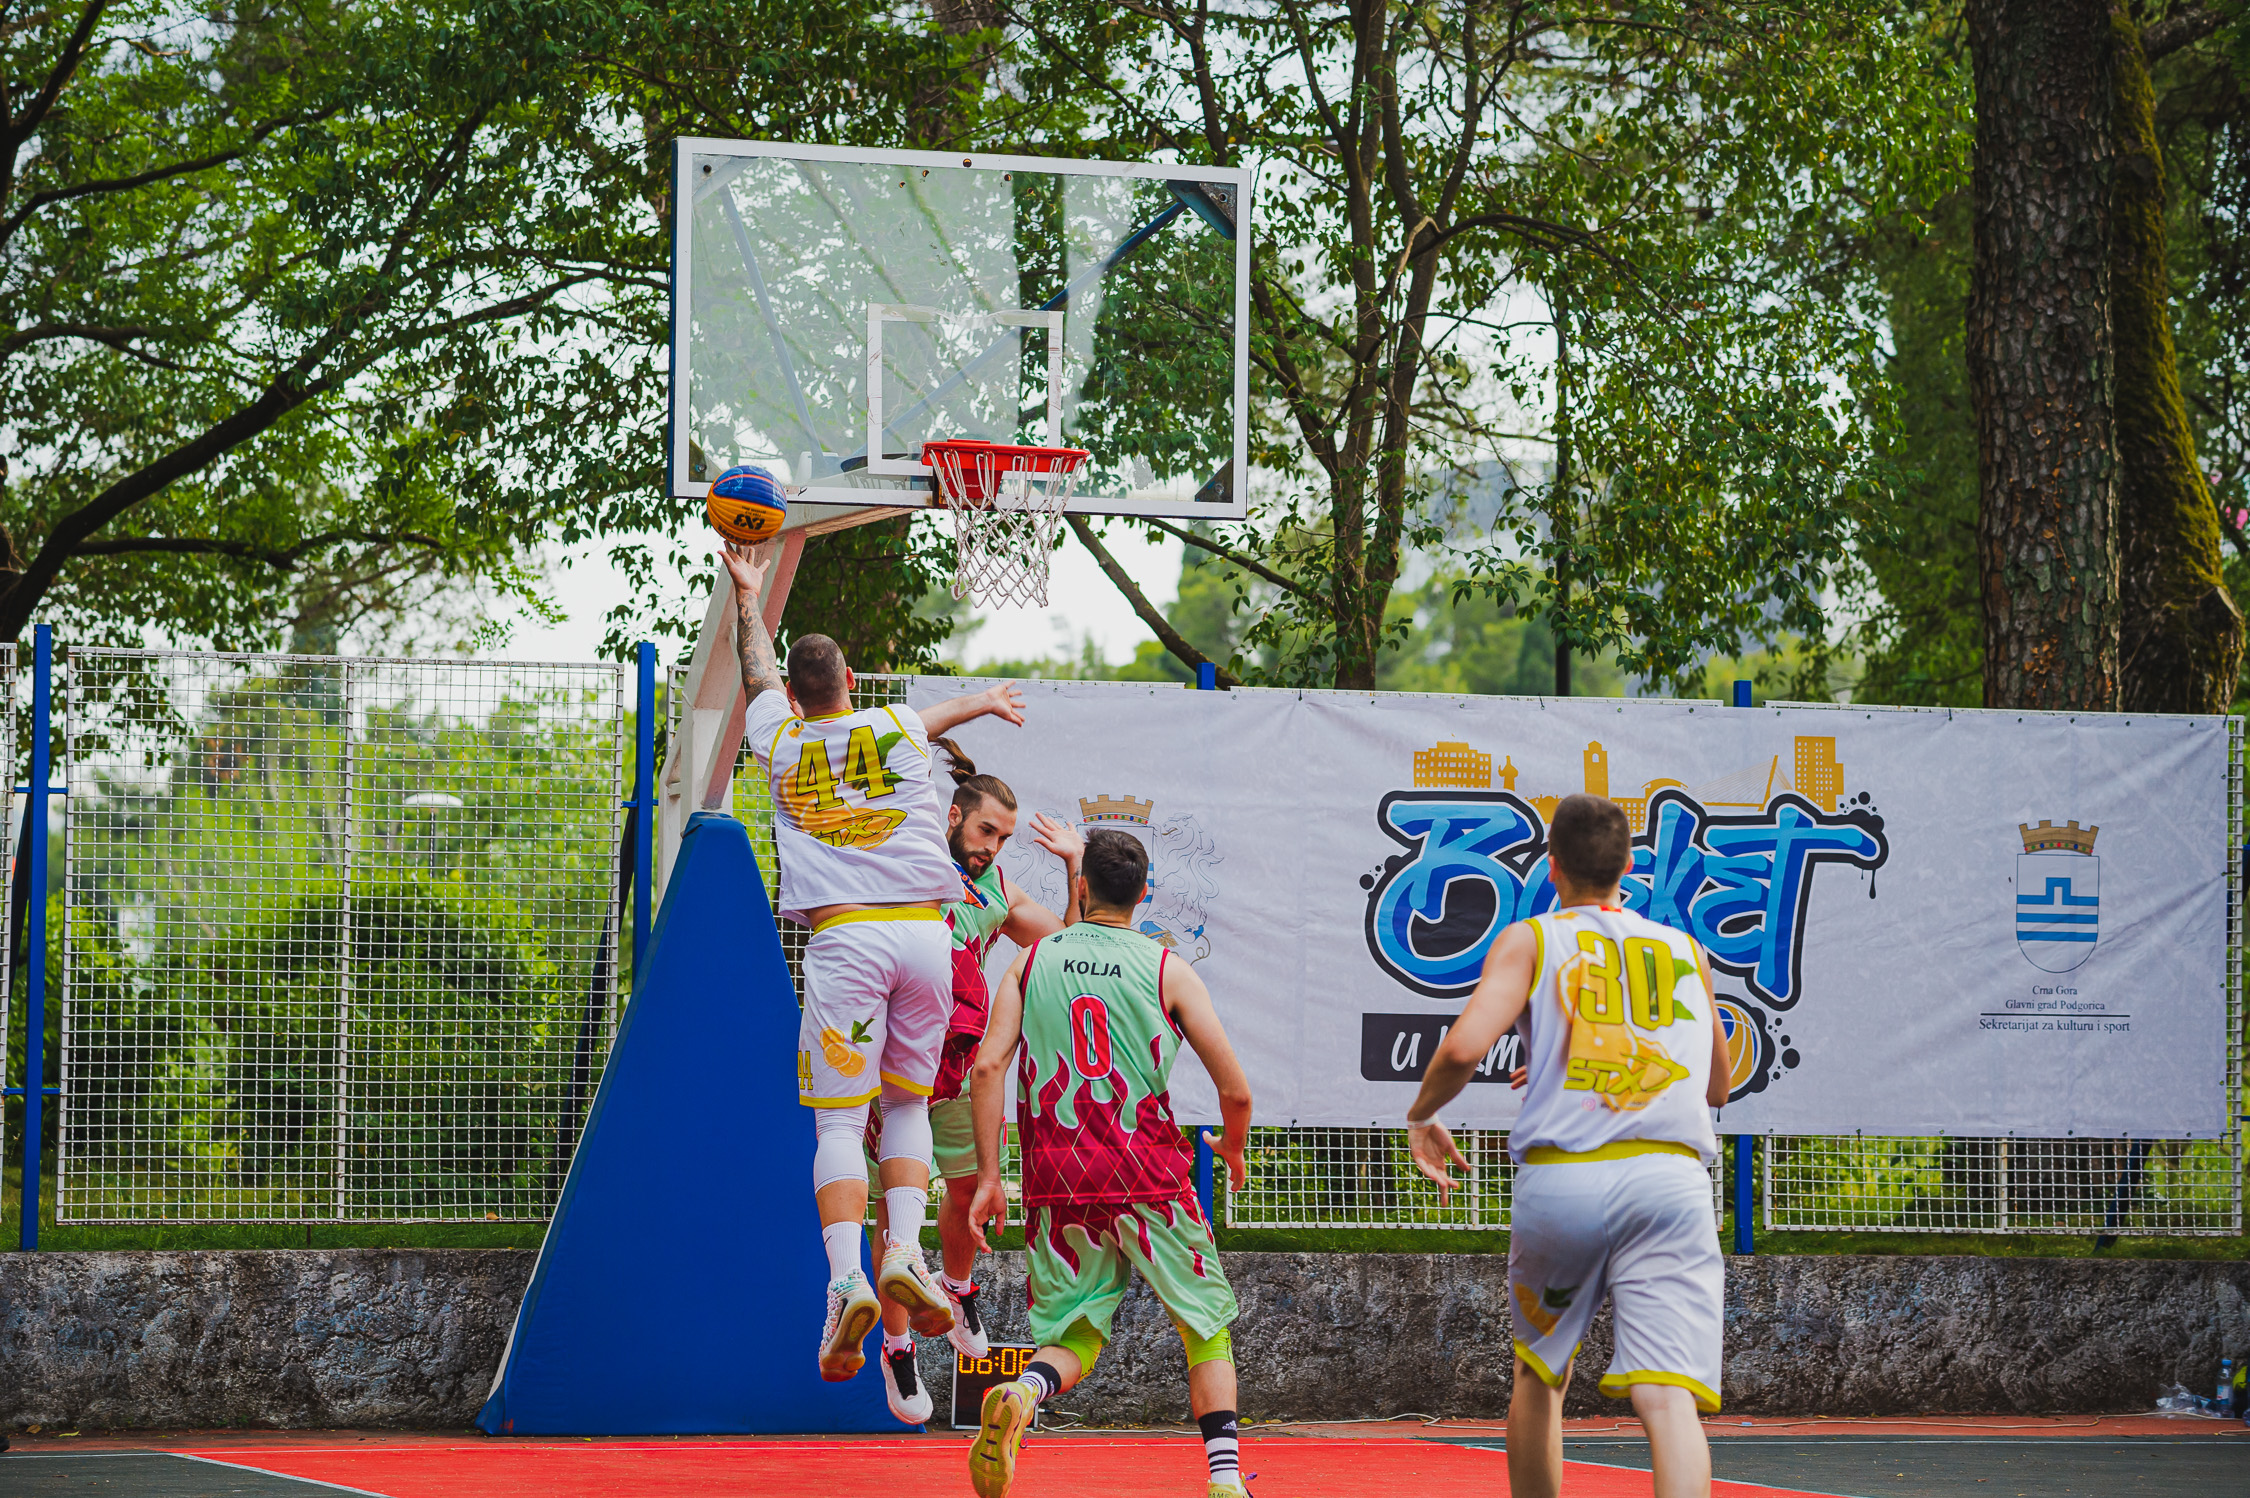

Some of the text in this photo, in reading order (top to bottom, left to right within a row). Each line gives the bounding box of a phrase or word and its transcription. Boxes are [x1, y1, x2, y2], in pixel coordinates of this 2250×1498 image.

[795, 724, 897, 813] 44
[1063, 958, 1122, 979] KOLJA
[1575, 930, 1676, 1031] 30
[2032, 985, 2078, 995] Crna Gora
[2005, 999, 2105, 1012] Glavni grad Podgorica
[1069, 993, 1114, 1081] 0
[1979, 1018, 2039, 1032] Sekretarijat
[2041, 1021, 2054, 1031] za
[2057, 1019, 2094, 1031] kulturu
[2103, 1021, 2130, 1034] sport
[797, 1050, 813, 1090] 44
